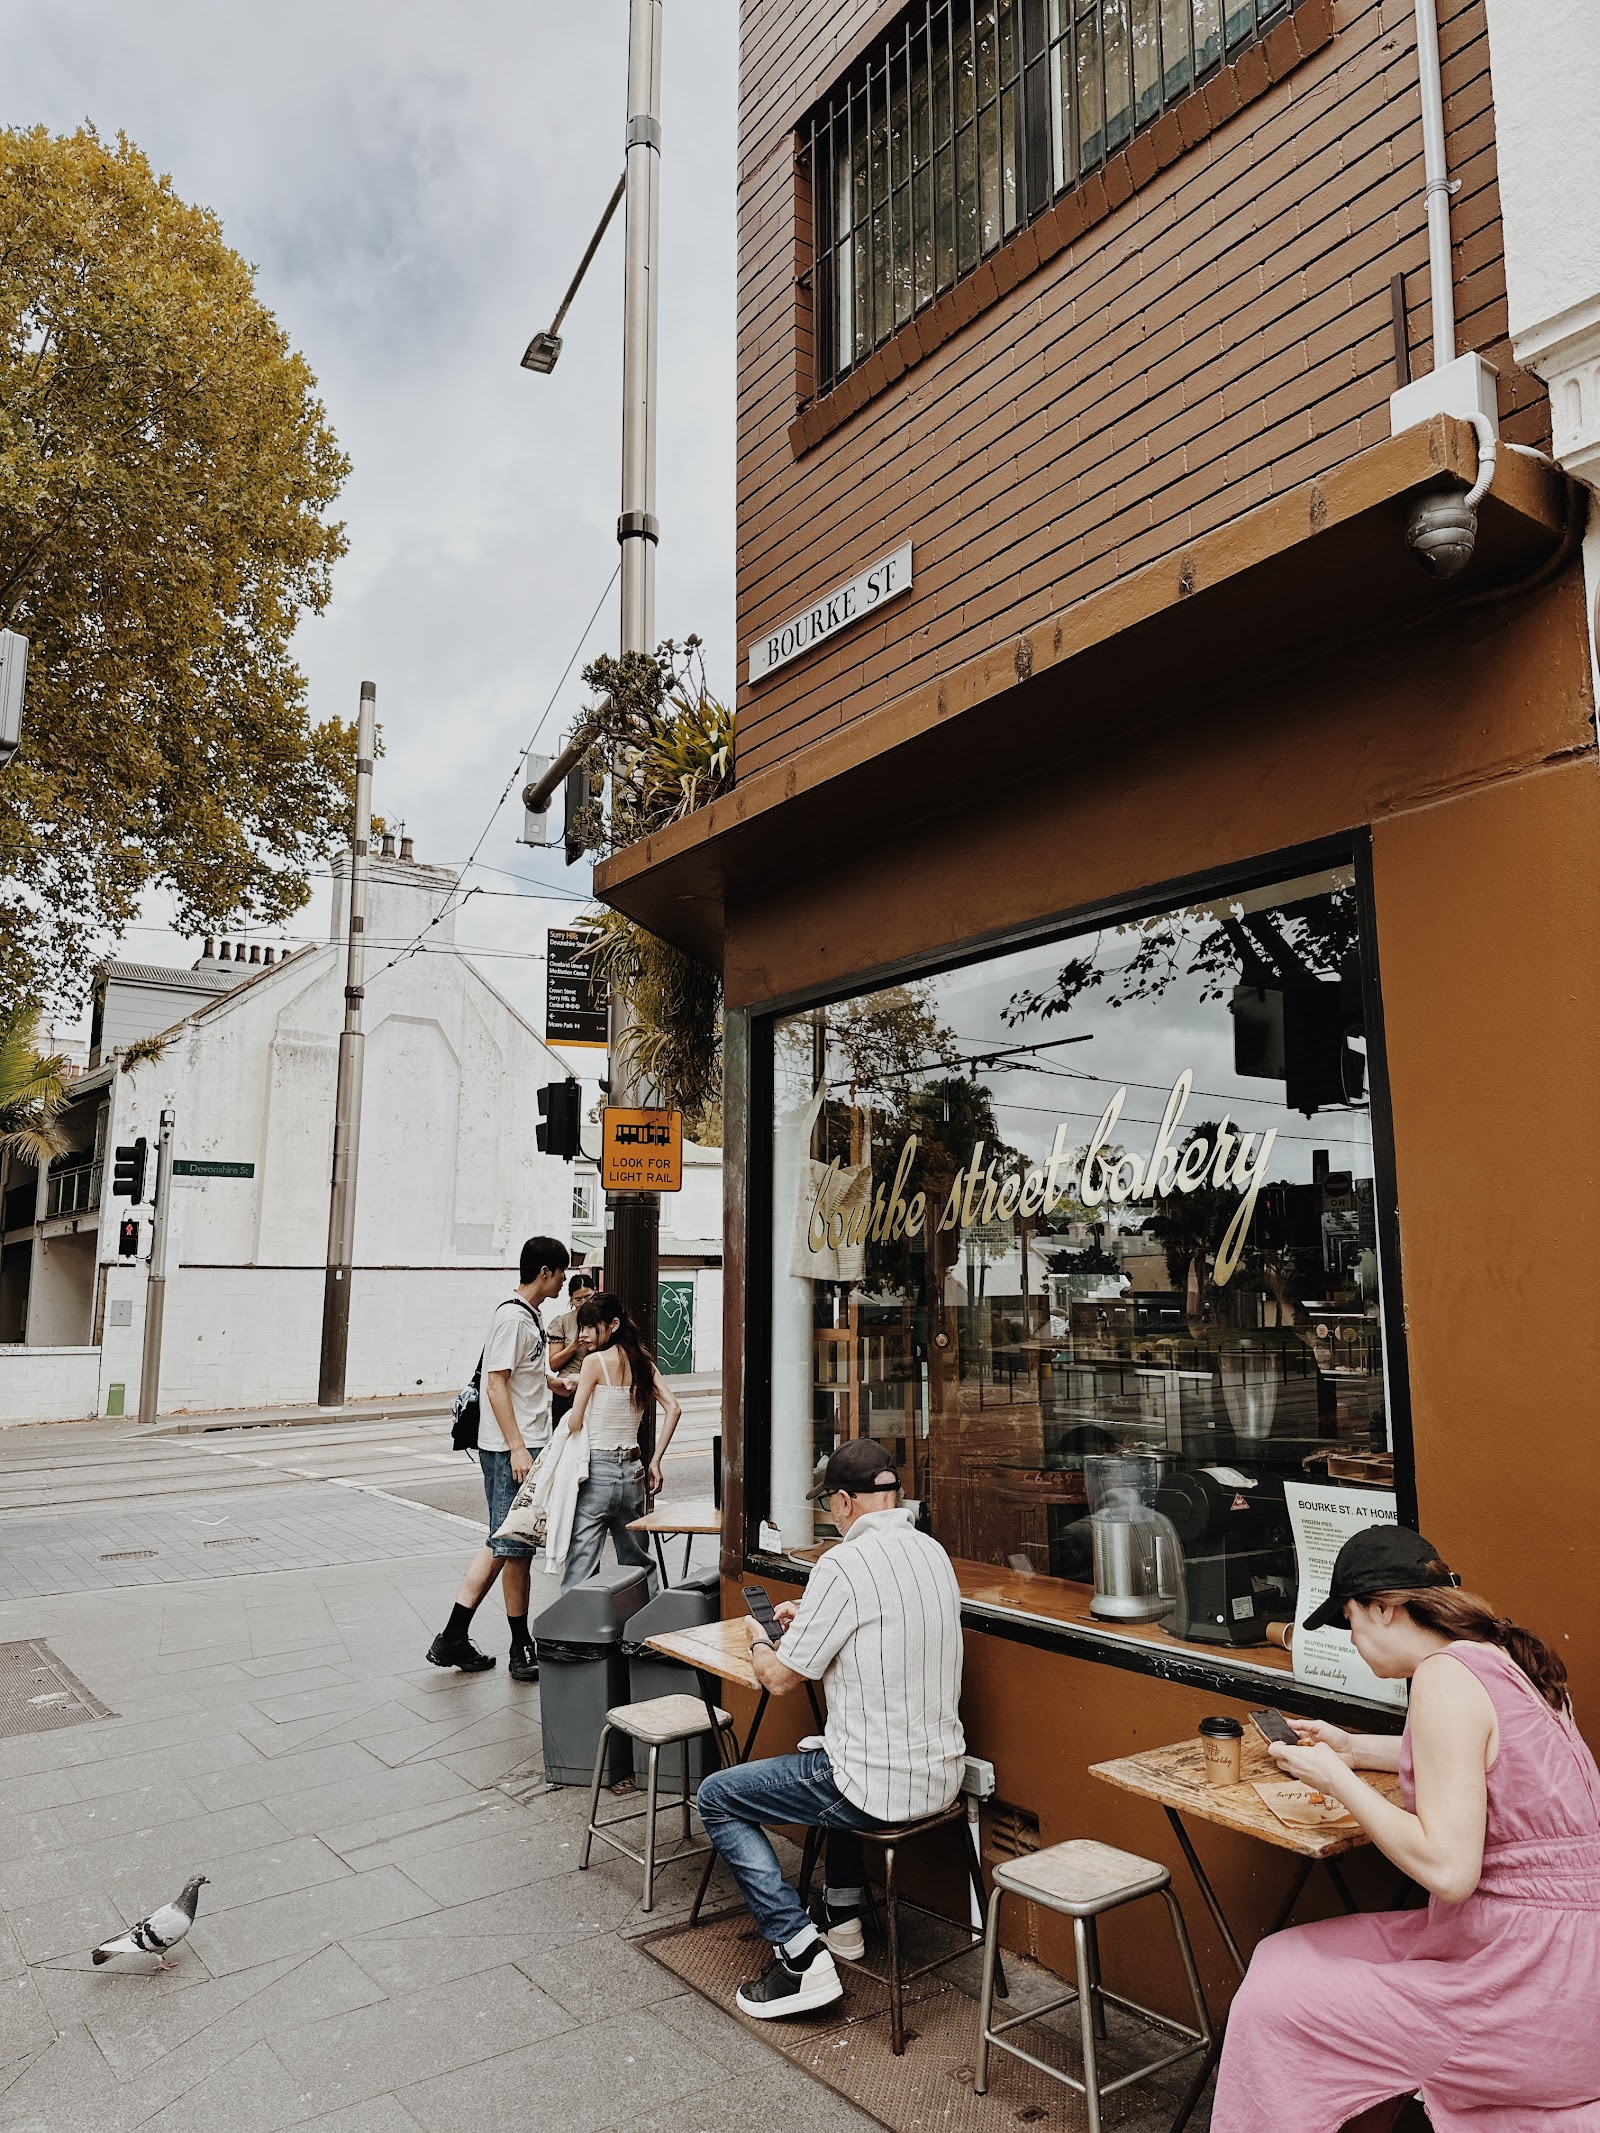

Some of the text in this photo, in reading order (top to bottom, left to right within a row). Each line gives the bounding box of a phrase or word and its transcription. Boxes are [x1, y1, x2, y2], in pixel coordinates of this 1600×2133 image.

[766, 560, 897, 668] BOURKE ST
[549, 930, 578, 940] Surry Hills
[549, 939, 575, 947] Devonshire
[612, 1157, 671, 1169] LOOK FOR
[190, 1164, 249, 1175] Devonshire St
[610, 1171, 673, 1183] LIGHT RAIL
[807, 1134, 926, 1253] bourke
[936, 1122, 1069, 1234] street
[1080, 1067, 1278, 1287] bakery
[1298, 1500, 1398, 1520] BOURKE ST. AT HOME
[1308, 1557, 1328, 1565] FROZEN
[1304, 1639, 1356, 1654] GLUTEN FREE BREAD
